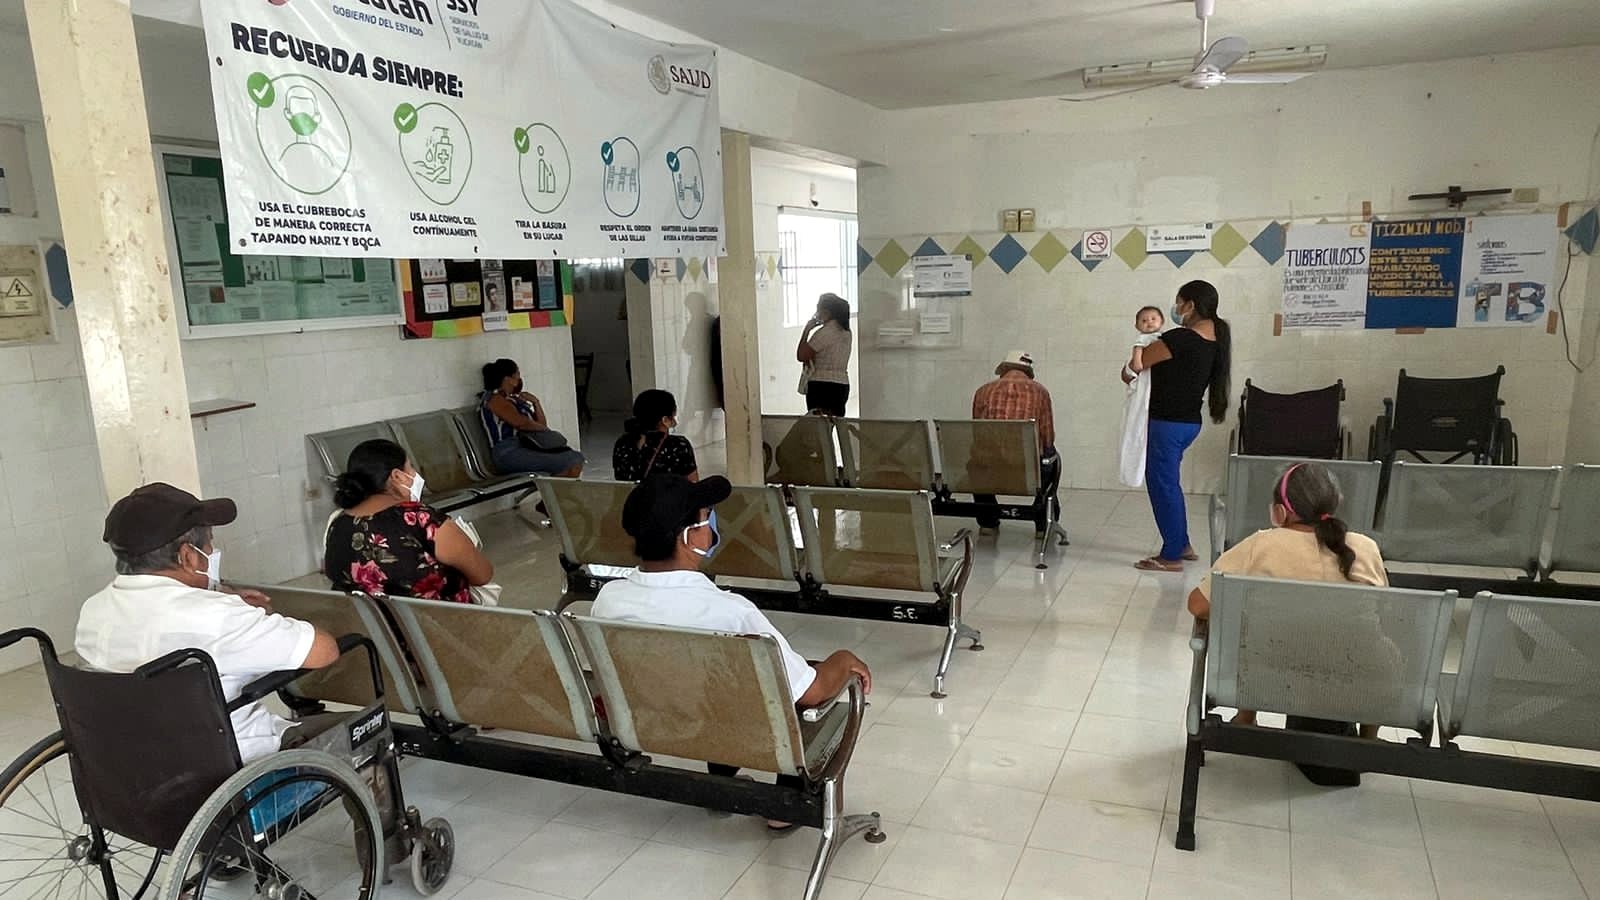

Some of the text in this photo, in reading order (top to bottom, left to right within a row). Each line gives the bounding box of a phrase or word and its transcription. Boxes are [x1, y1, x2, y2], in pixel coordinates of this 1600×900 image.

[332, 5, 424, 37] GOBIERNO DEL ESTADO
[230, 22, 463, 98] RECUERDA SIEMPRE:
[258, 201, 366, 218] USA EL CUBREBOCAS
[410, 211, 477, 225] USA ALCOHOL GEL
[255, 216, 372, 233] DE MANERA CORRECTA
[515, 219, 567, 230] TIRA LA BASURA
[250, 232, 381, 248] TAPANDO NARIZ Y BOCA
[523, 231, 533, 240] EN
[533, 232, 542, 240] SU
[1286, 246, 1366, 267] TUBERCULOSIS
